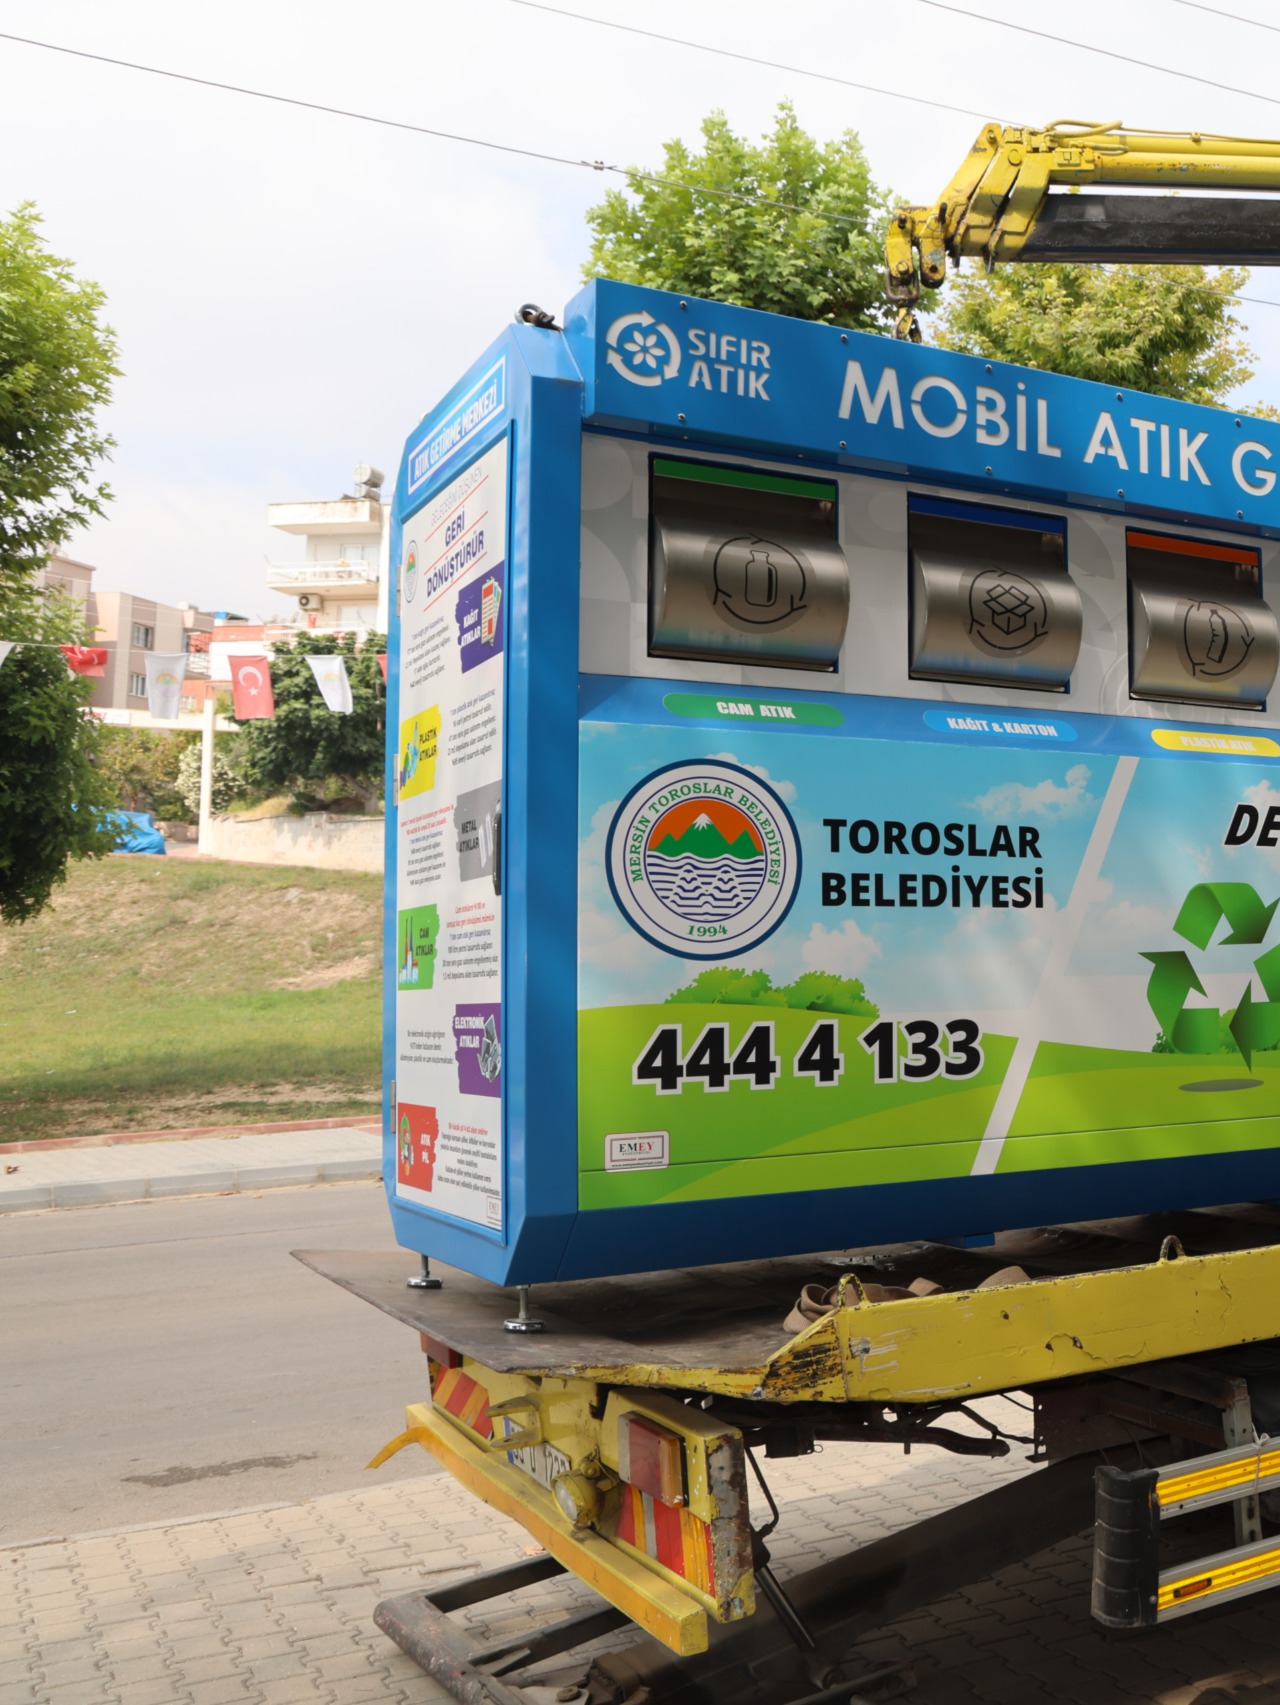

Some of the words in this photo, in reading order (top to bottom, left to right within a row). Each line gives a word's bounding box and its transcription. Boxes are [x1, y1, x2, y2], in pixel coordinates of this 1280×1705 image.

[688, 328, 771, 369] SIFIR
[688, 359, 771, 401] ATIK
[838, 360, 1062, 458] MOBİL
[1083, 410, 1211, 487] ATIK
[445, 505, 465, 547] GERİ
[427, 529, 484, 598] DÖNÜŞTÜRÜR
[716, 701, 754, 716] CAM
[759, 704, 796, 719] ATIK
[946, 717, 989, 732] KAĞIT
[991, 722, 1002, 733] &
[1003, 722, 1059, 737] KARTON
[629, 815, 651, 883] MERSİN
[648, 782, 735, 816] TOROSLAR
[737, 794, 781, 886] BELEDİYESİ
[823, 818, 1042, 859] TOROSLAR
[821, 864, 1044, 909] BELEDİYESİ
[420, 927, 430, 939] CAM
[687, 924, 728, 938] 1994
[635, 1023, 779, 1093] 444
[796, 1022, 842, 1084] 4
[861, 1018, 983, 1081] 133
[619, 1141, 655, 1153] EMEY
